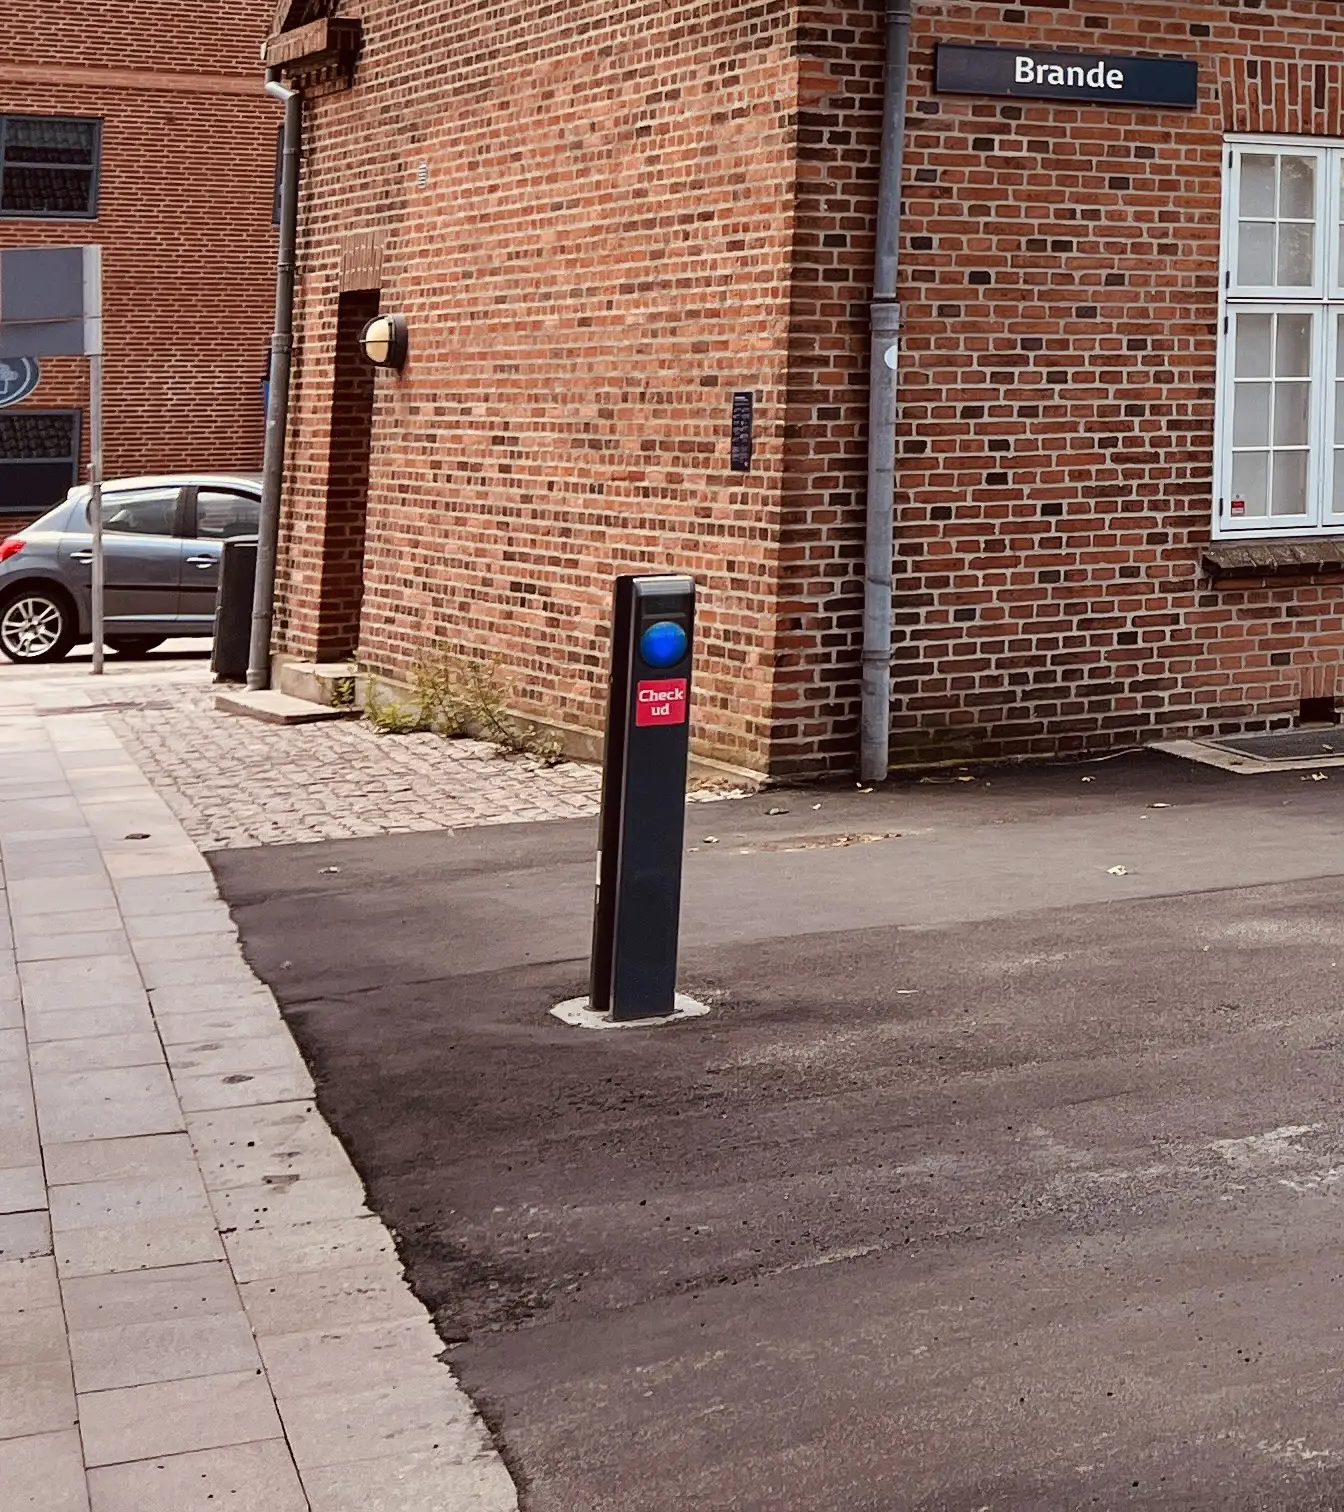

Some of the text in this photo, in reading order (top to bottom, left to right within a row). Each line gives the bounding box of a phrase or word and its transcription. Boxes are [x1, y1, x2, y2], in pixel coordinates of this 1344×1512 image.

[1014, 56, 1124, 89] Brande
[639, 688, 684, 702] Check
[650, 703, 670, 717] ud
